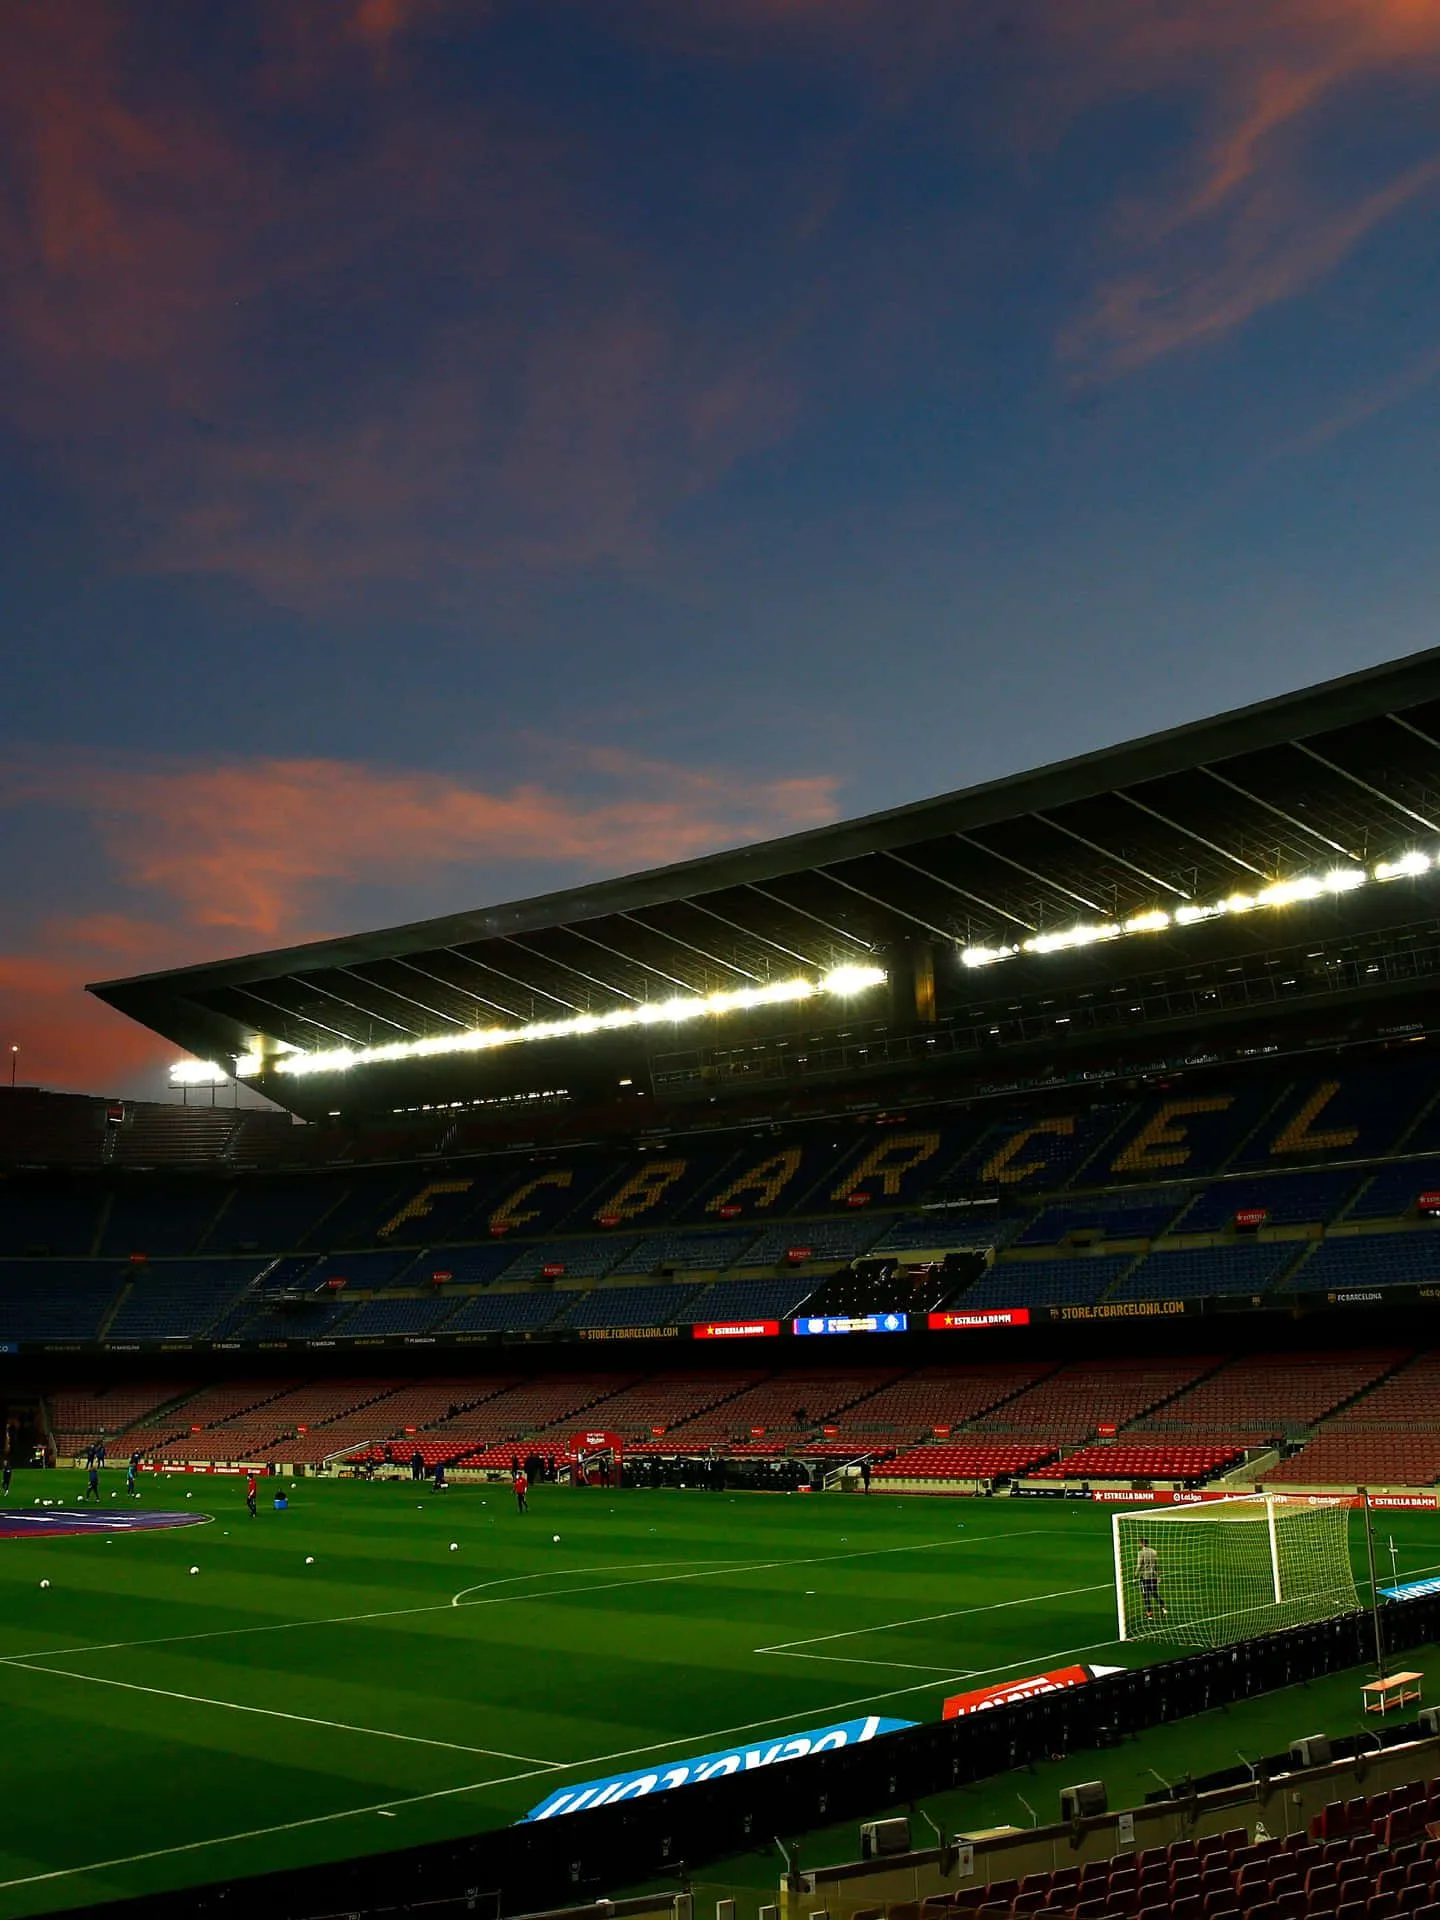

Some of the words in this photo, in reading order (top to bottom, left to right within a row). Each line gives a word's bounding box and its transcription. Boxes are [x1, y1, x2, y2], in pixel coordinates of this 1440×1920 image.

[1061, 1301, 1184, 1320] STORE.FCBARCELONA.COM
[954, 1315, 988, 1325] ESTRELLA
[988, 1313, 1011, 1324] DAMM
[587, 1327, 679, 1340] STORE.FCBARCELONA.COM
[714, 1327, 744, 1336] ESTRELLA
[1104, 1490, 1134, 1500] ESTRELLA
[1134, 1490, 1154, 1500] DAMM
[1181, 1493, 1202, 1502] LaLiga
[1375, 1498, 1408, 1506] ESTRELLA
[1408, 1498, 1435, 1506] DAMM
